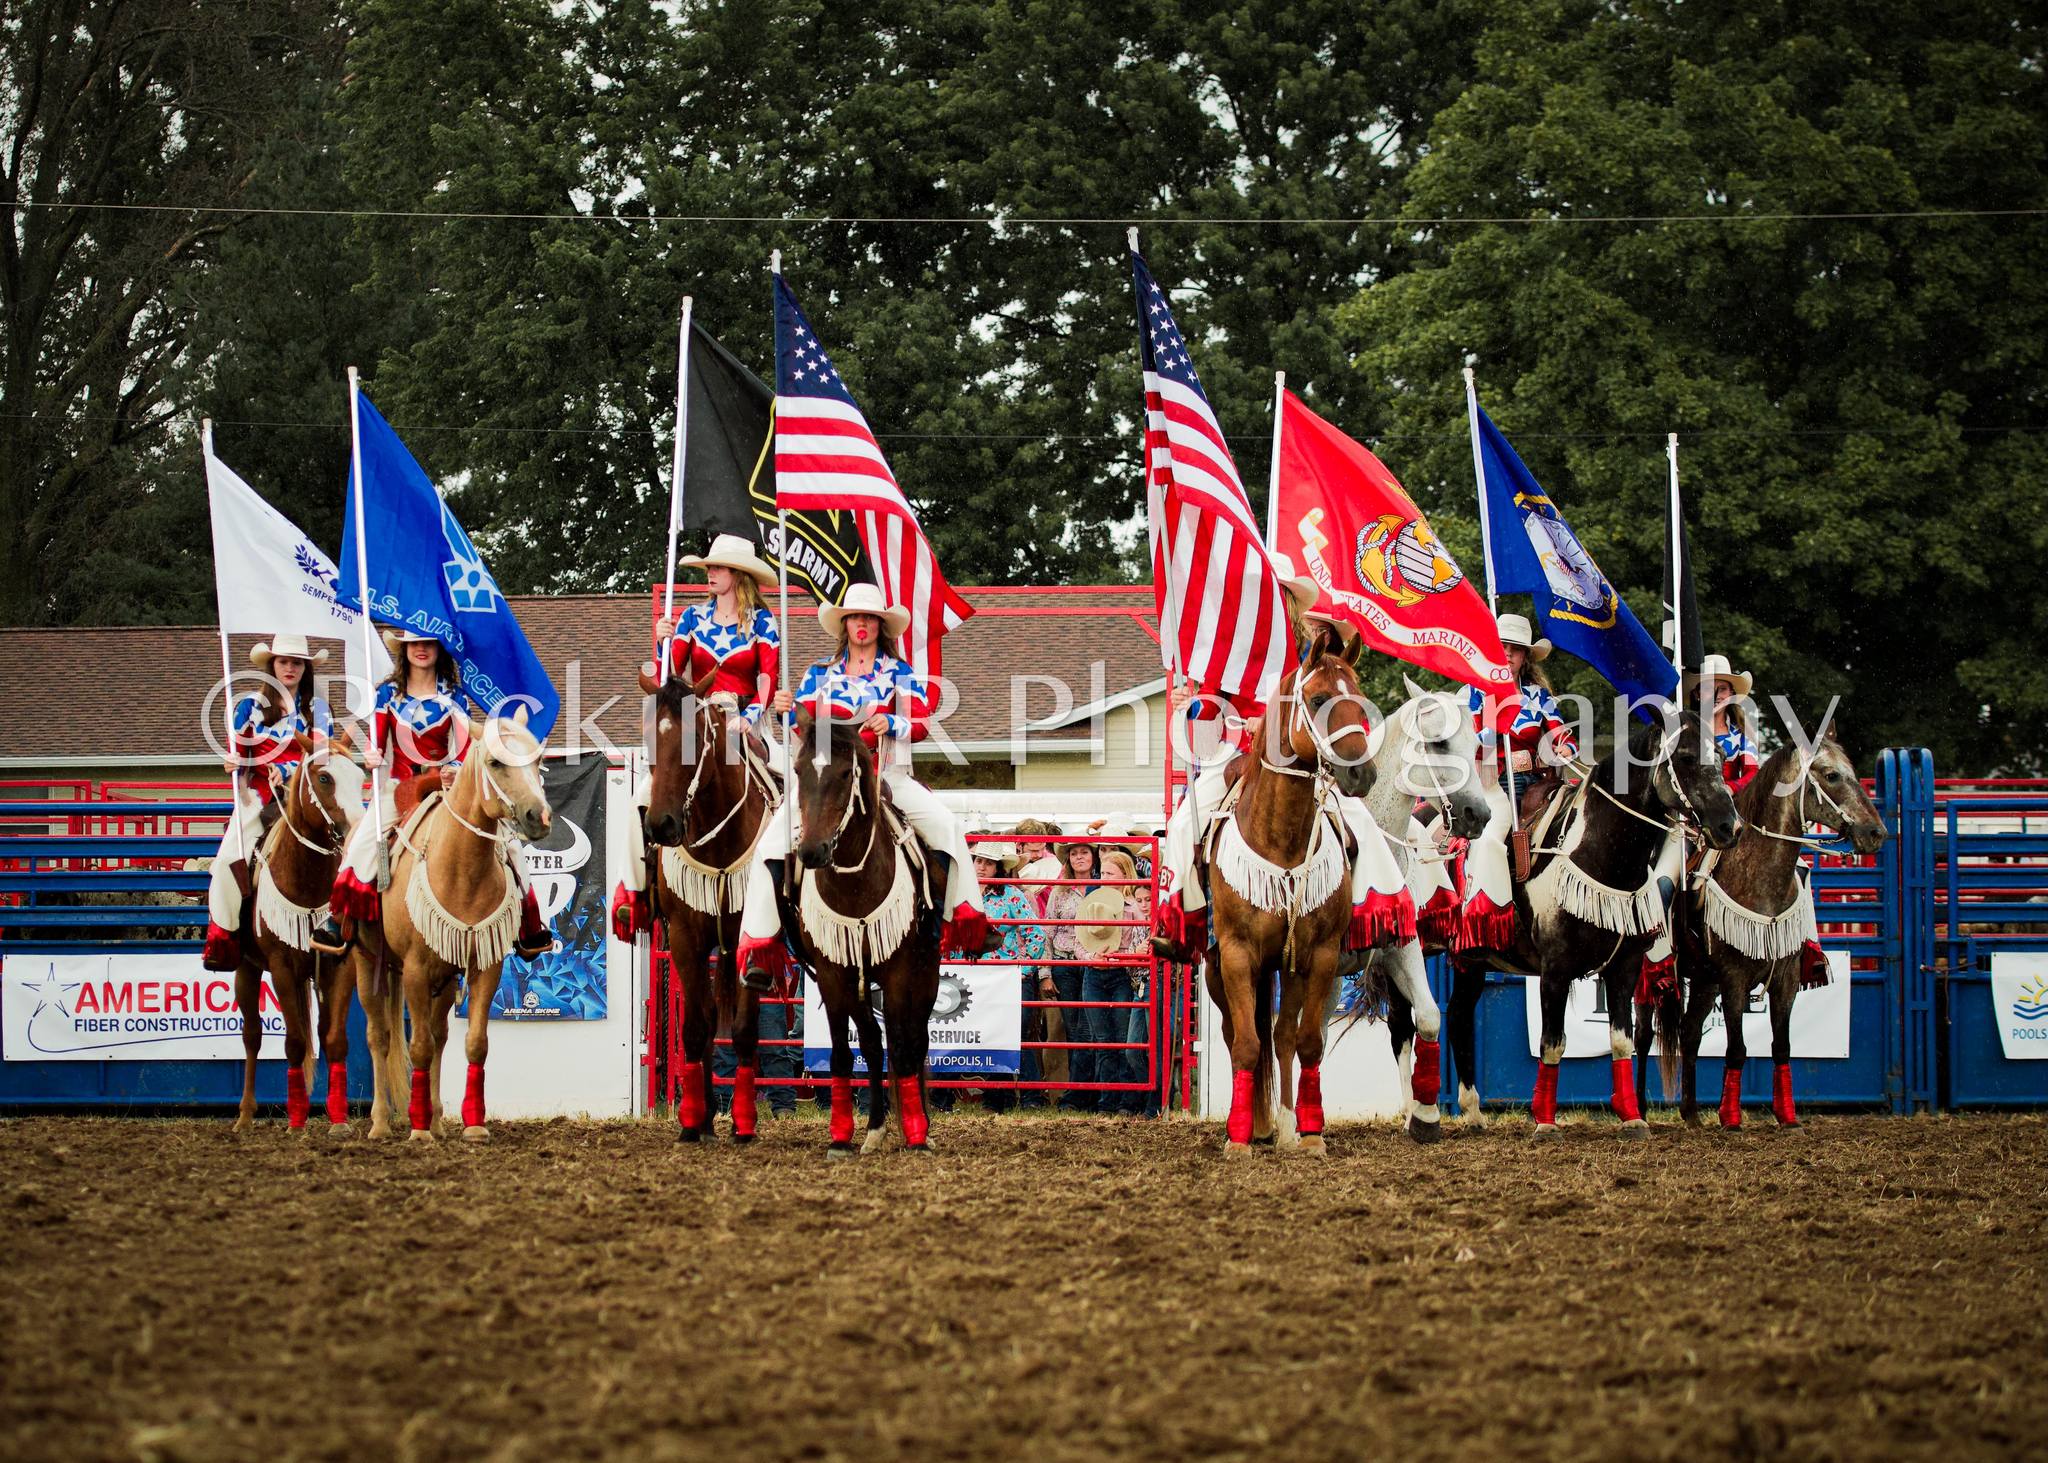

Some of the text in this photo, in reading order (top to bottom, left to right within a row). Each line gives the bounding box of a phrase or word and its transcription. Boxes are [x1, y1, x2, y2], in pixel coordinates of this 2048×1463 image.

[785, 537, 840, 595] ARMY
[301, 583, 338, 605] SEMPE
[330, 606, 353, 625] 1790
[1339, 592, 1391, 631] TATES
[1412, 631, 1477, 661] MARINE
[74, 981, 284, 1014] AMERICN
[75, 1018, 120, 1032] FIBER
[259, 1017, 286, 1031] NC.
[2012, 1028, 2048, 1040] POOLS
[930, 1030, 981, 1044] SERVICE
[985, 1056, 995, 1066] IL
